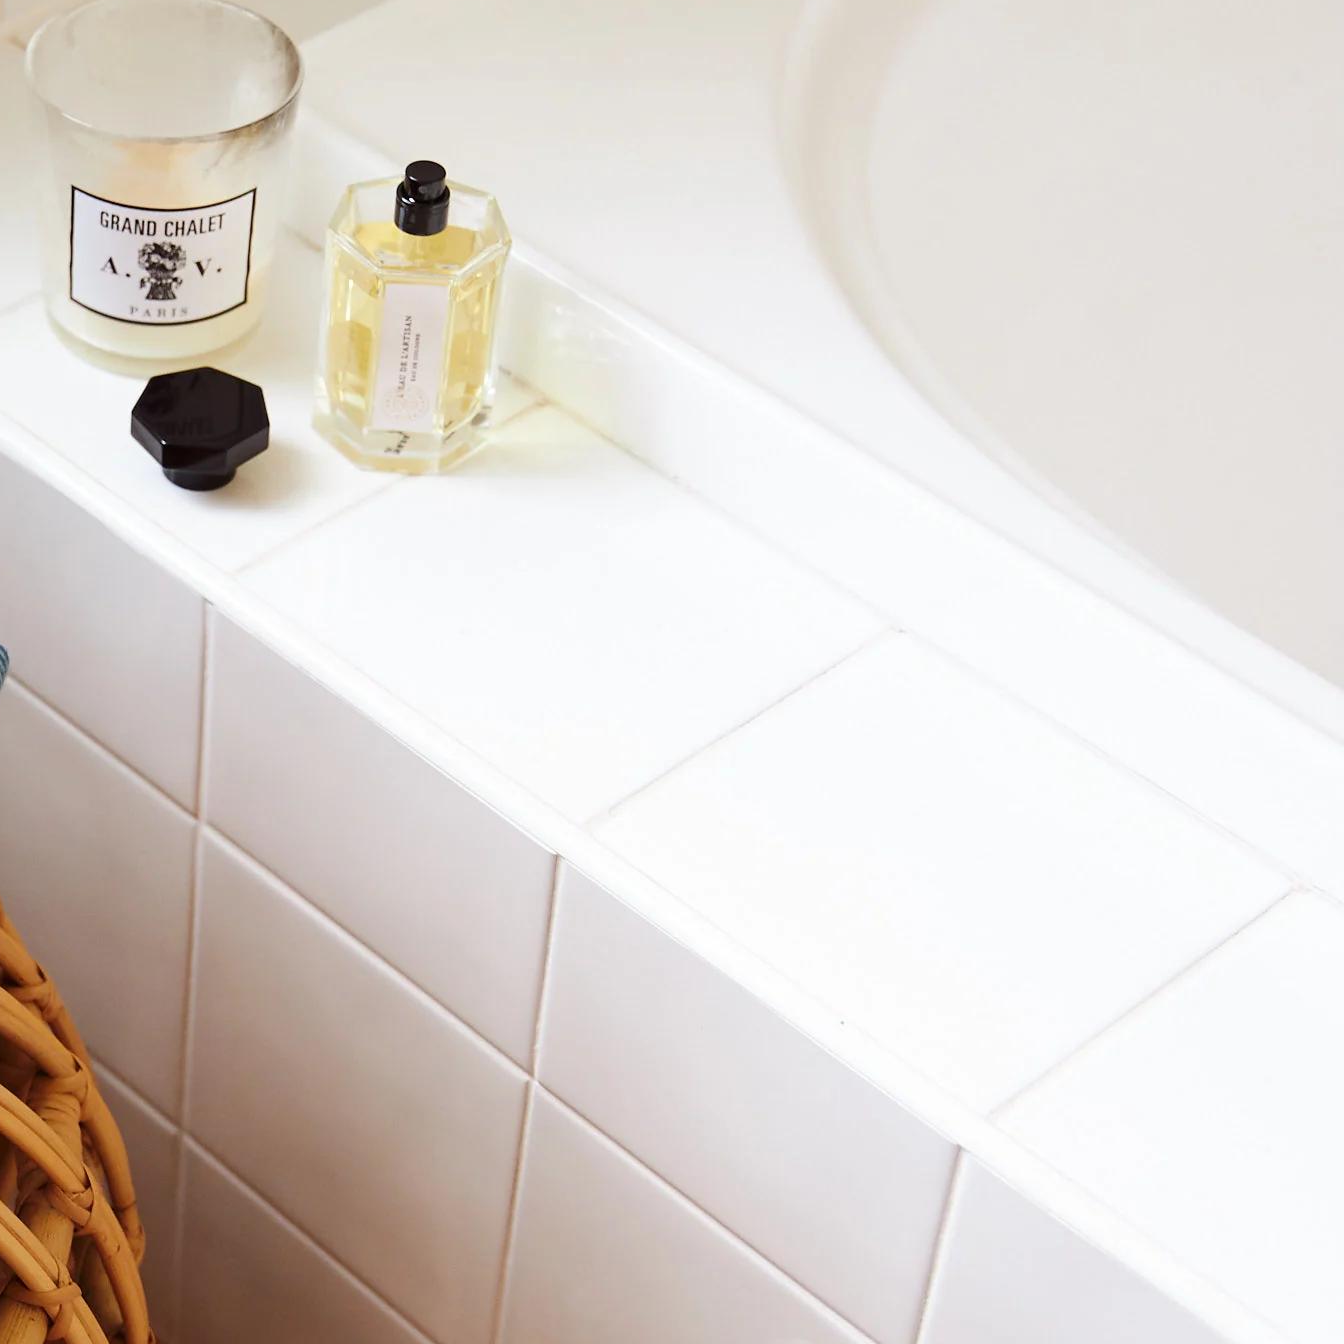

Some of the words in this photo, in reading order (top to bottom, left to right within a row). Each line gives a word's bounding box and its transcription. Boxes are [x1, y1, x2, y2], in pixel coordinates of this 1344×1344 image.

[100, 211, 157, 237] GRAND
[164, 212, 226, 237] CHALET
[100, 256, 131, 278] A.
[194, 258, 222, 277] V.
[130, 306, 188, 318] PARIS
[401, 315, 412, 360] L'ARTISAN
